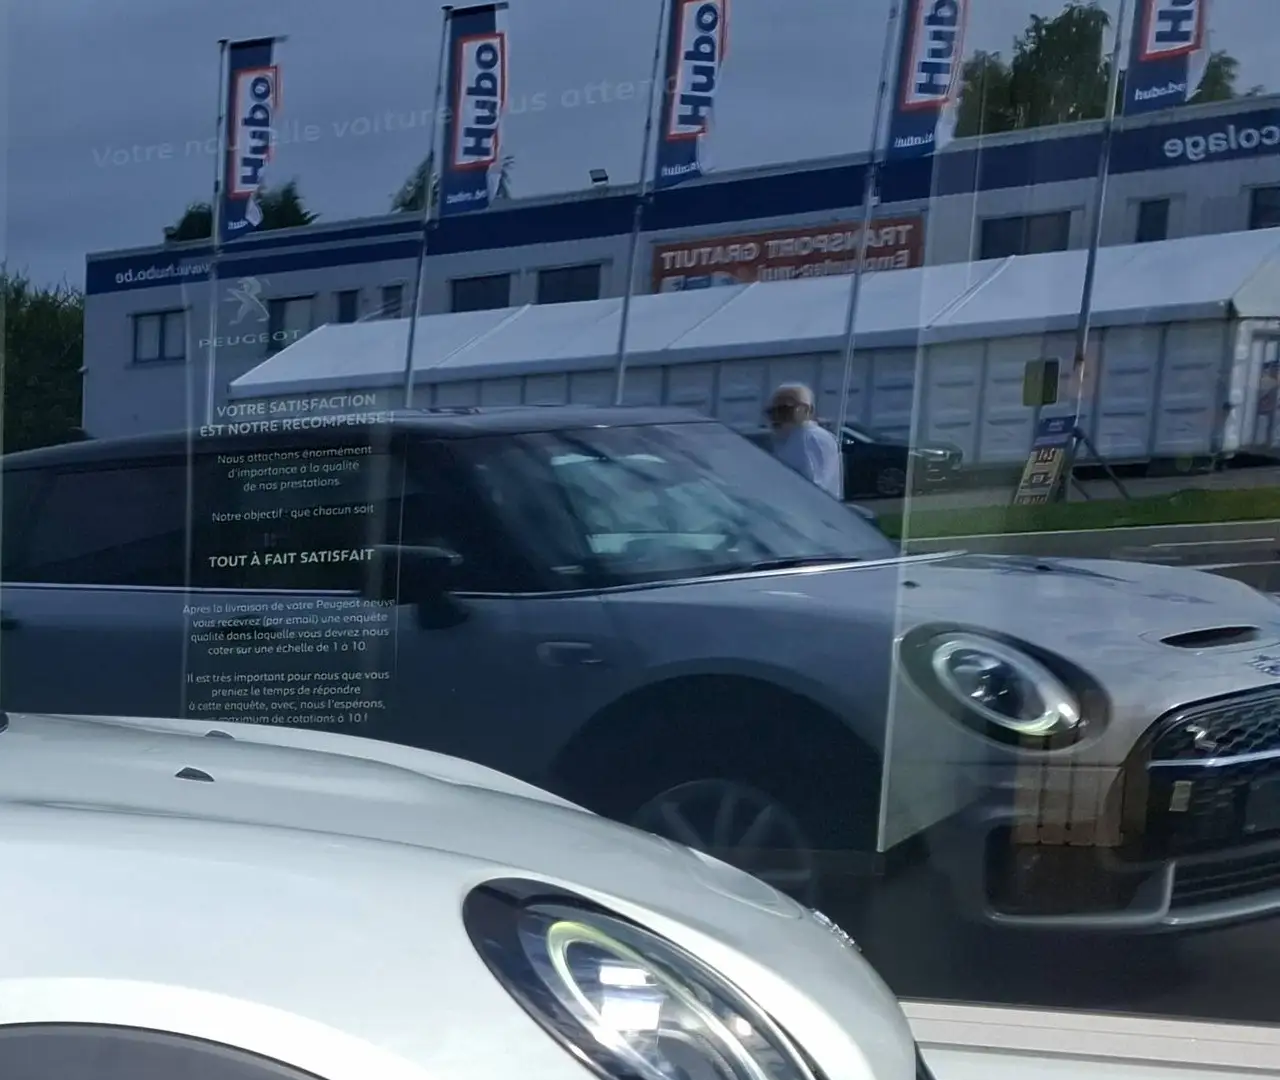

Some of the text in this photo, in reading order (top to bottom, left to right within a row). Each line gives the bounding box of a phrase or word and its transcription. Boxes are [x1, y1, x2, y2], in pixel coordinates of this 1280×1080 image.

[1155, 0, 1194, 43] H
[677, 2, 719, 126] Hubo
[462, 43, 499, 156] Hubo
[240, 77, 270, 185] Hubo
[91, 141, 174, 169] Votre
[184, 119, 321, 157] noelle
[199, 329, 300, 349] PEUGEOT
[217, 393, 376, 417] VOTRE SATISFACTION
[200, 424, 224, 437] EST
[228, 420, 278, 435] NOTRE
[217, 445, 372, 464] Nous attachons énormément
[227, 466, 298, 479] d'importance
[309, 462, 320, 473] la
[323, 460, 360, 473] qualité
[243, 481, 257, 492] de
[259, 482, 278, 491] nos
[211, 512, 241, 522] Notre
[243, 508, 283, 522] objectif
[290, 508, 311, 519] que
[313, 505, 351, 516] chacun
[353, 504, 374, 514] soit
[208, 548, 375, 568] TOUT À FAIT SATISFAIT
[213, 603, 223, 613] la
[225, 603, 268, 613] livraison
[271, 601, 284, 611] de
[286, 601, 314, 610] votre
[316, 599, 360, 611] Peugeot
[192, 619, 215, 628] vous
[218, 618, 261, 627] recevrez
[263, 616, 284, 627] (par
[321, 615, 340, 624] une
[226, 631, 252, 641] dans
[254, 628, 295, 641] laquelle
[297, 630, 322, 639] vous
[324, 628, 360, 638] devrez
[362, 628, 390, 637] nous
[208, 646, 233, 655] coter
[236, 646, 253, 655] sur
[255, 645, 274, 654] une
[276, 641, 314, 653] échelle
[316, 642, 329, 652] de
[333, 642, 338, 652] 1
[187, 671, 390, 683] Il est très important pour nous que vous
[211, 684, 361, 698] preniez le temps de répondre
[197, 702, 222, 711] cette
[300, 701, 325, 709] nous
[271, 714, 285, 723] de
[287, 713, 335, 723] cotations
[349, 712, 361, 723] 10
